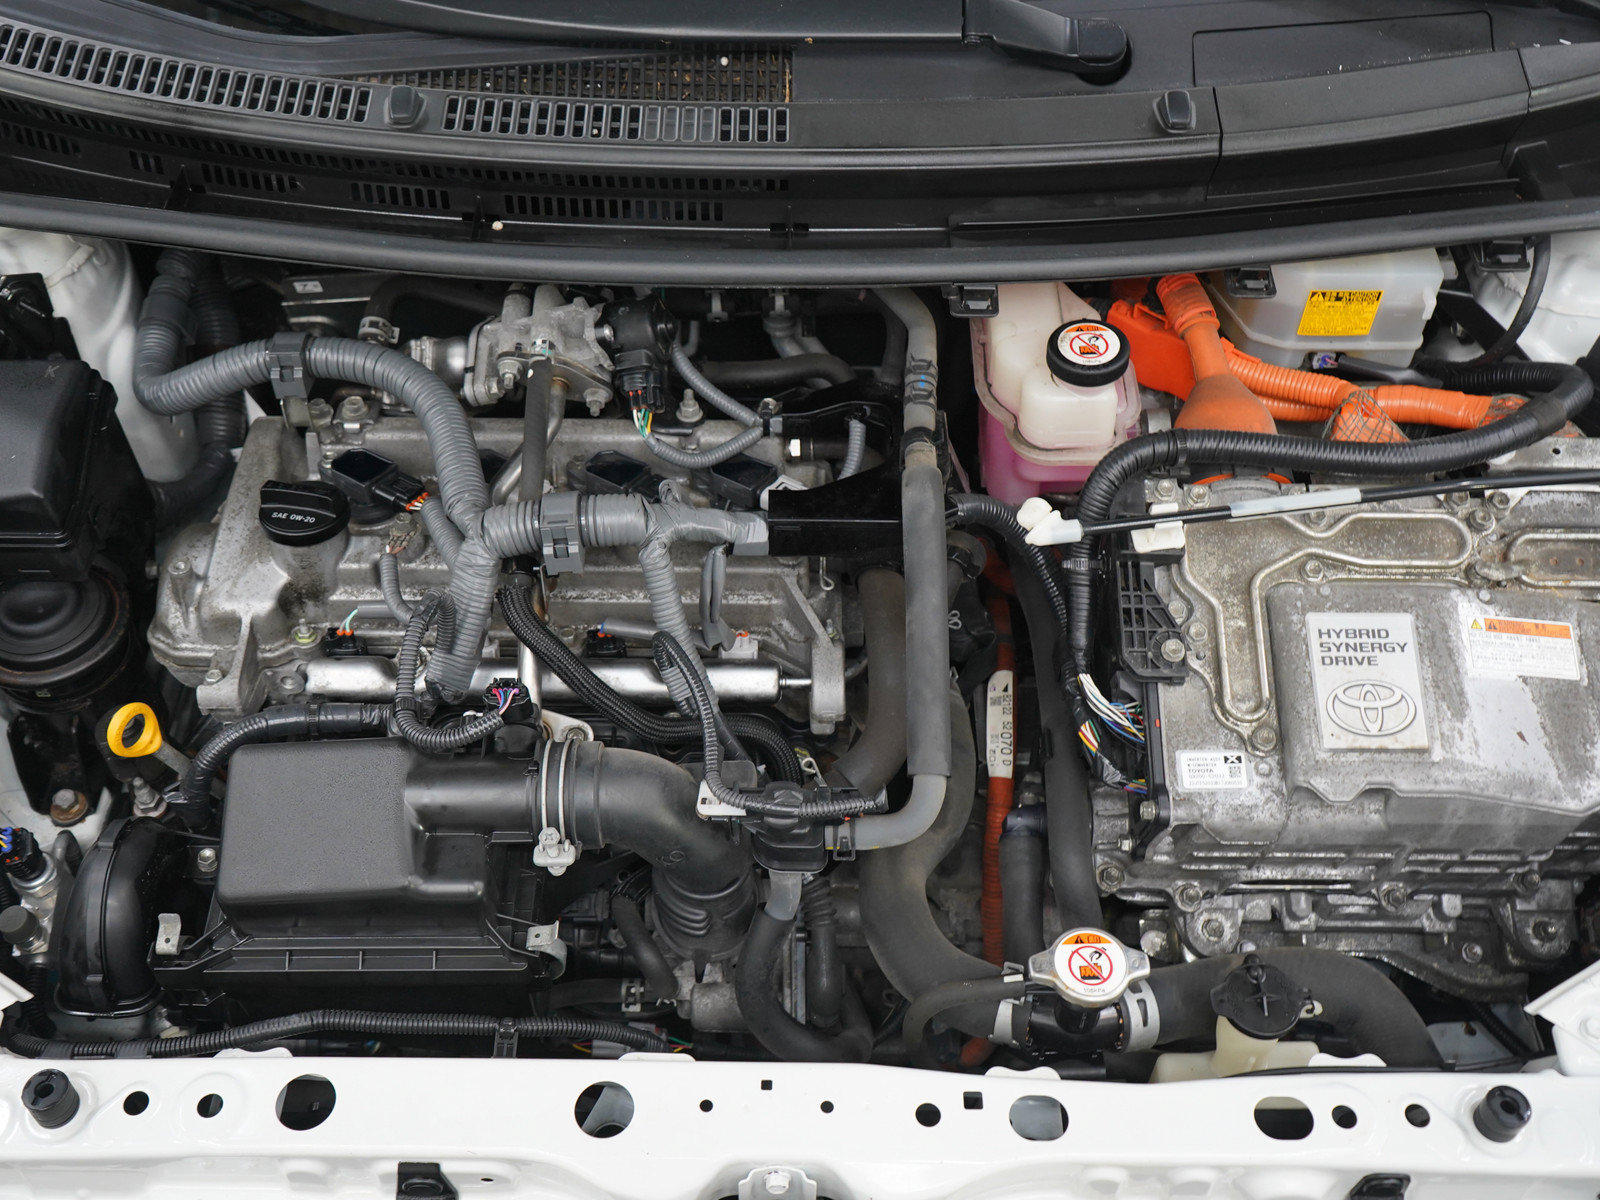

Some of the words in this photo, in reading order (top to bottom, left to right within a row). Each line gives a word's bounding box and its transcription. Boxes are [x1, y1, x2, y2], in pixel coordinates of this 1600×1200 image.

[271, 511, 288, 519] SAE
[289, 513, 316, 523] 0W-20
[1318, 628, 1390, 639] HYBRID
[1320, 642, 1408, 653] SYNERGY
[1321, 655, 1379, 666] DRIVE
